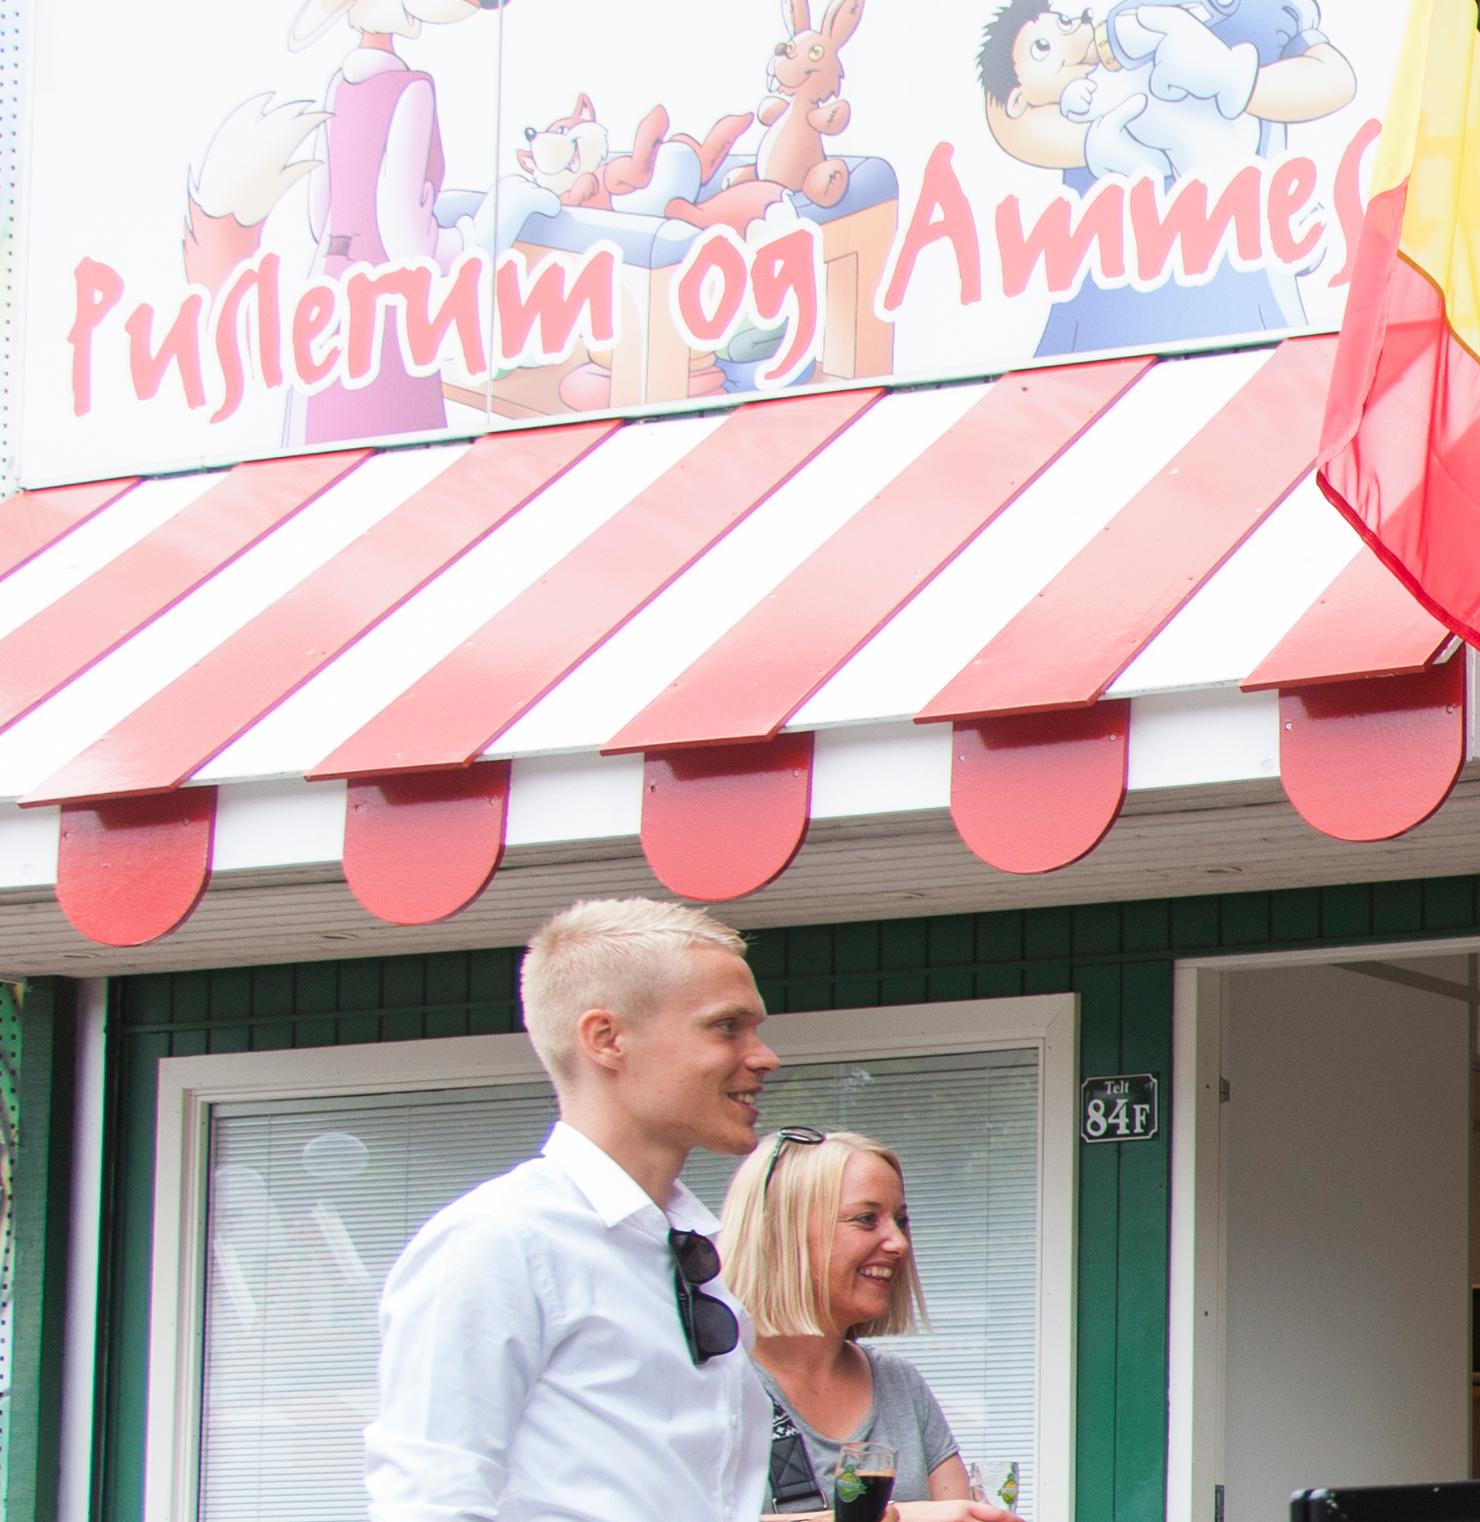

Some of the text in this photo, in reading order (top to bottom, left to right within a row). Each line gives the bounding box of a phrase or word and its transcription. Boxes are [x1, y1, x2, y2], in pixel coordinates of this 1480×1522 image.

[67, 243, 614, 423] Puslerum
[679, 229, 818, 381] og
[1104, 1080, 1130, 1094] Telt
